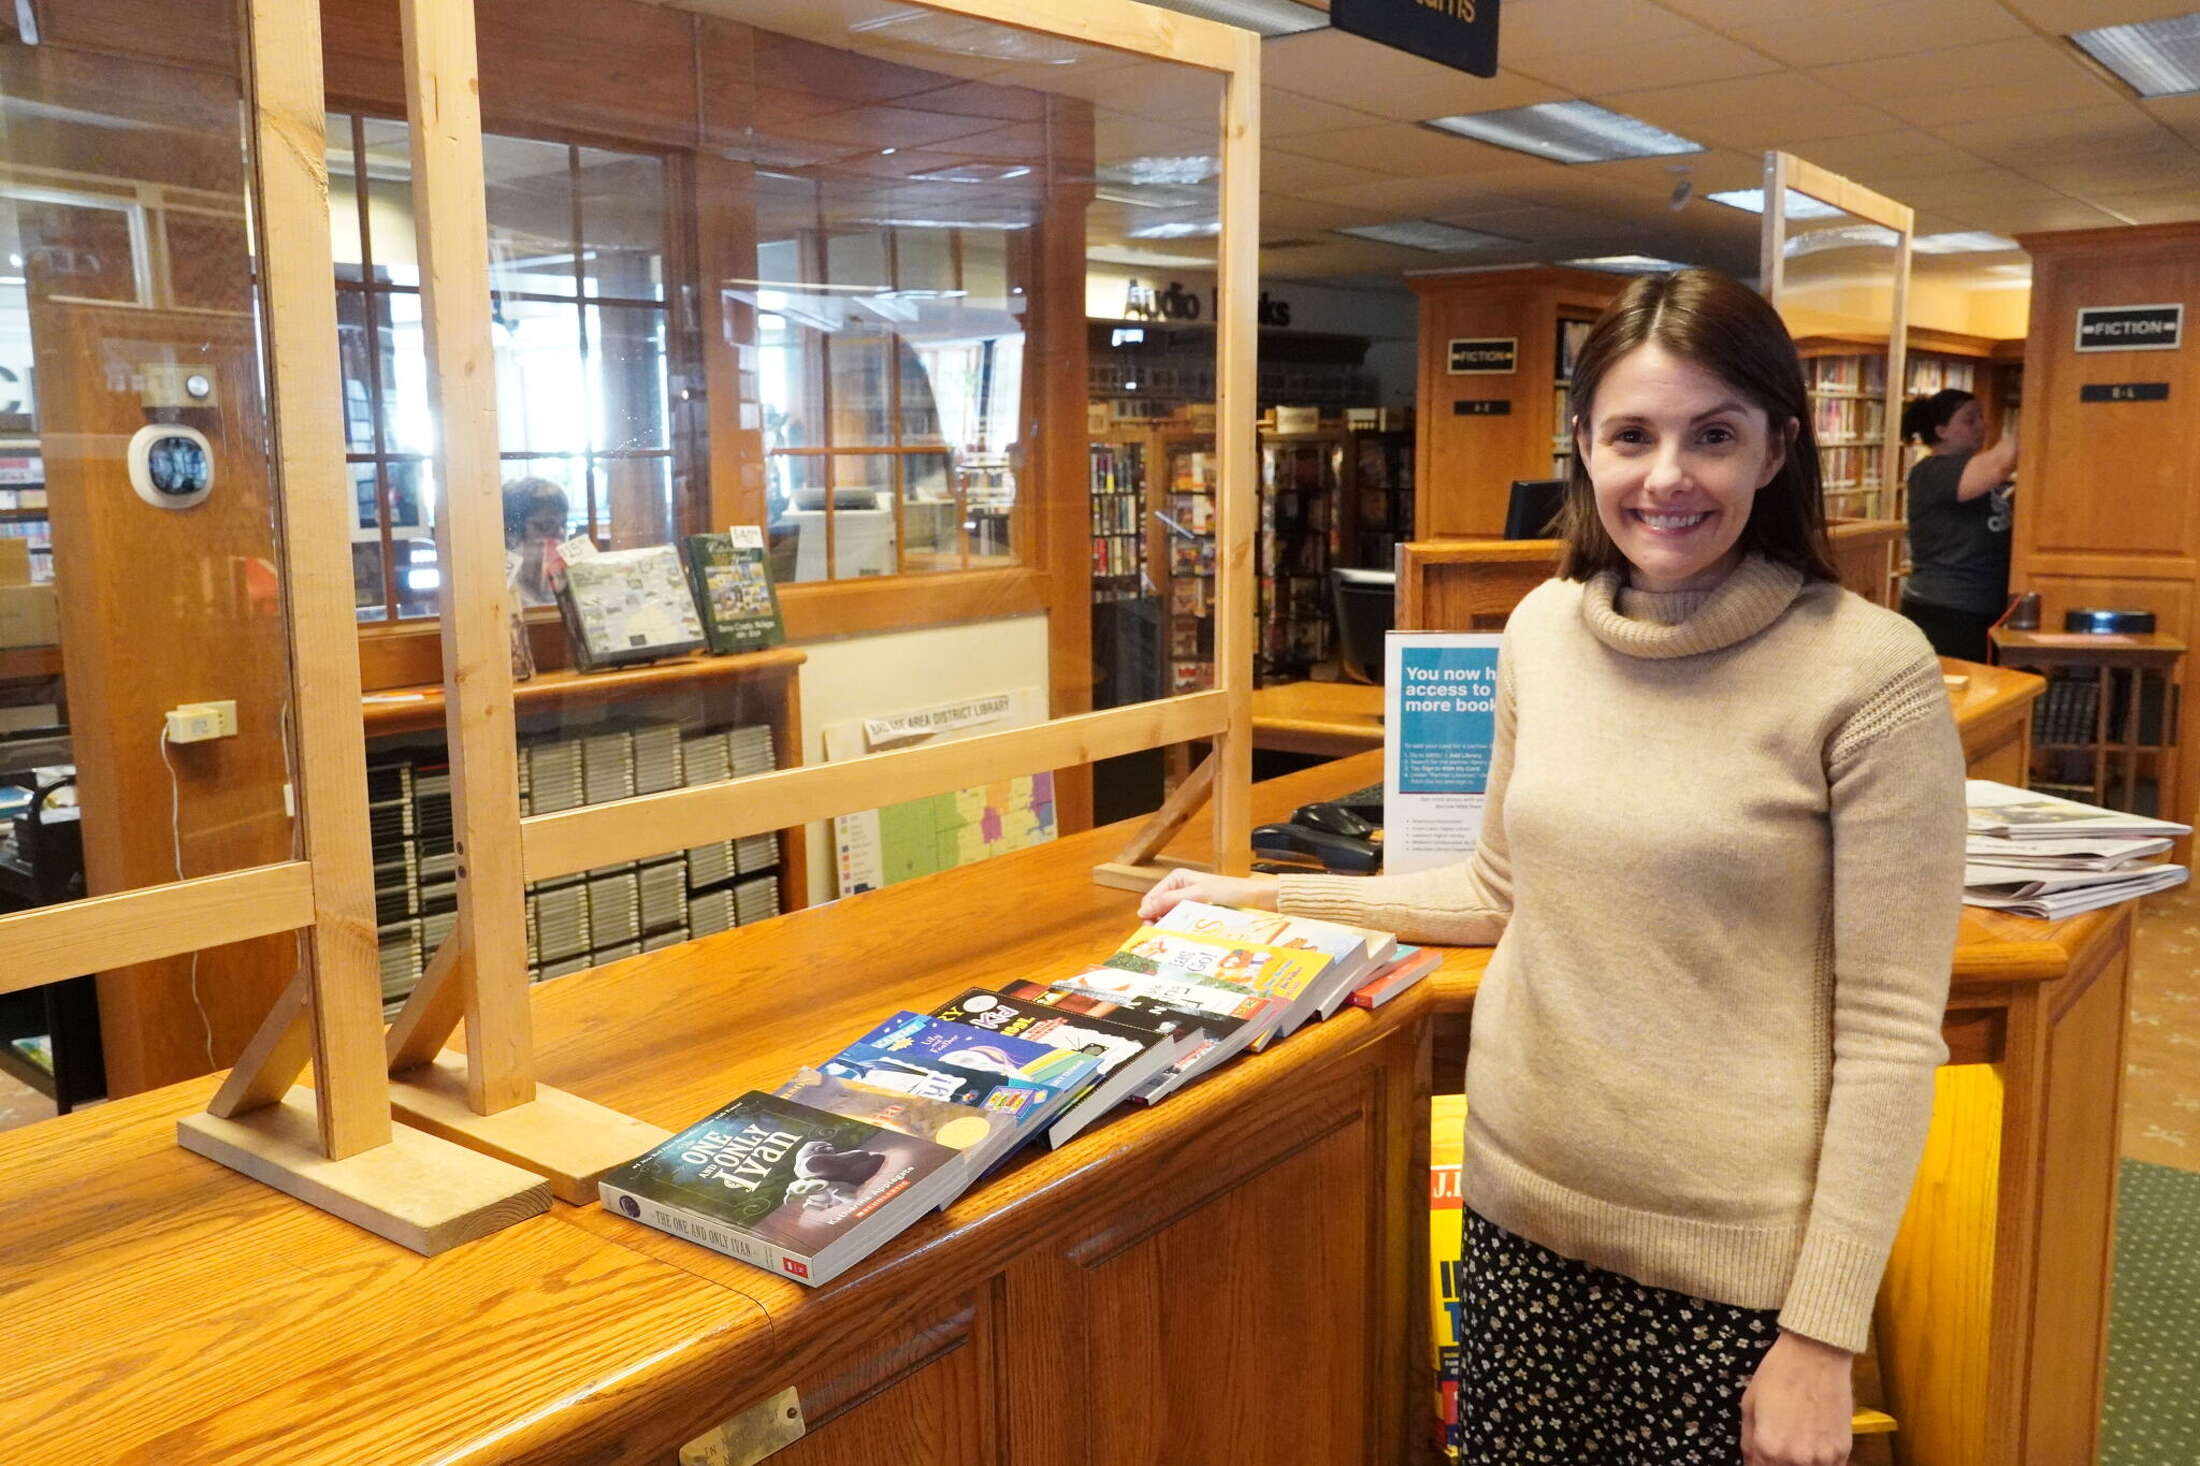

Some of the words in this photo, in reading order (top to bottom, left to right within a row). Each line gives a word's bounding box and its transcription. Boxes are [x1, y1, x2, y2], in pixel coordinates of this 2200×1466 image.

[2095, 320, 2162, 336] FICTION
[1406, 667, 1439, 681] You
[1443, 669, 1481, 681] now
[1405, 685, 1468, 697] access
[1472, 683, 1491, 697] to
[908, 714, 931, 729] AREA
[933, 705, 973, 726] DISTRICT
[974, 700, 1009, 718] LIBRARY
[1405, 700, 1451, 712] more
[968, 1004, 1020, 1030] Kid
[681, 1130, 734, 1165] ONE
[698, 1163, 720, 1179] AND
[713, 1123, 771, 1169] ONLY
[710, 1130, 804, 1194] Ivan
[871, 1165, 916, 1197] Applegate
[654, 1210, 673, 1229] THE
[672, 1216, 689, 1235] ONE
[691, 1221, 708, 1241] AND
[708, 1228, 729, 1250] ONLY
[730, 1236, 752, 1257] IVAN
